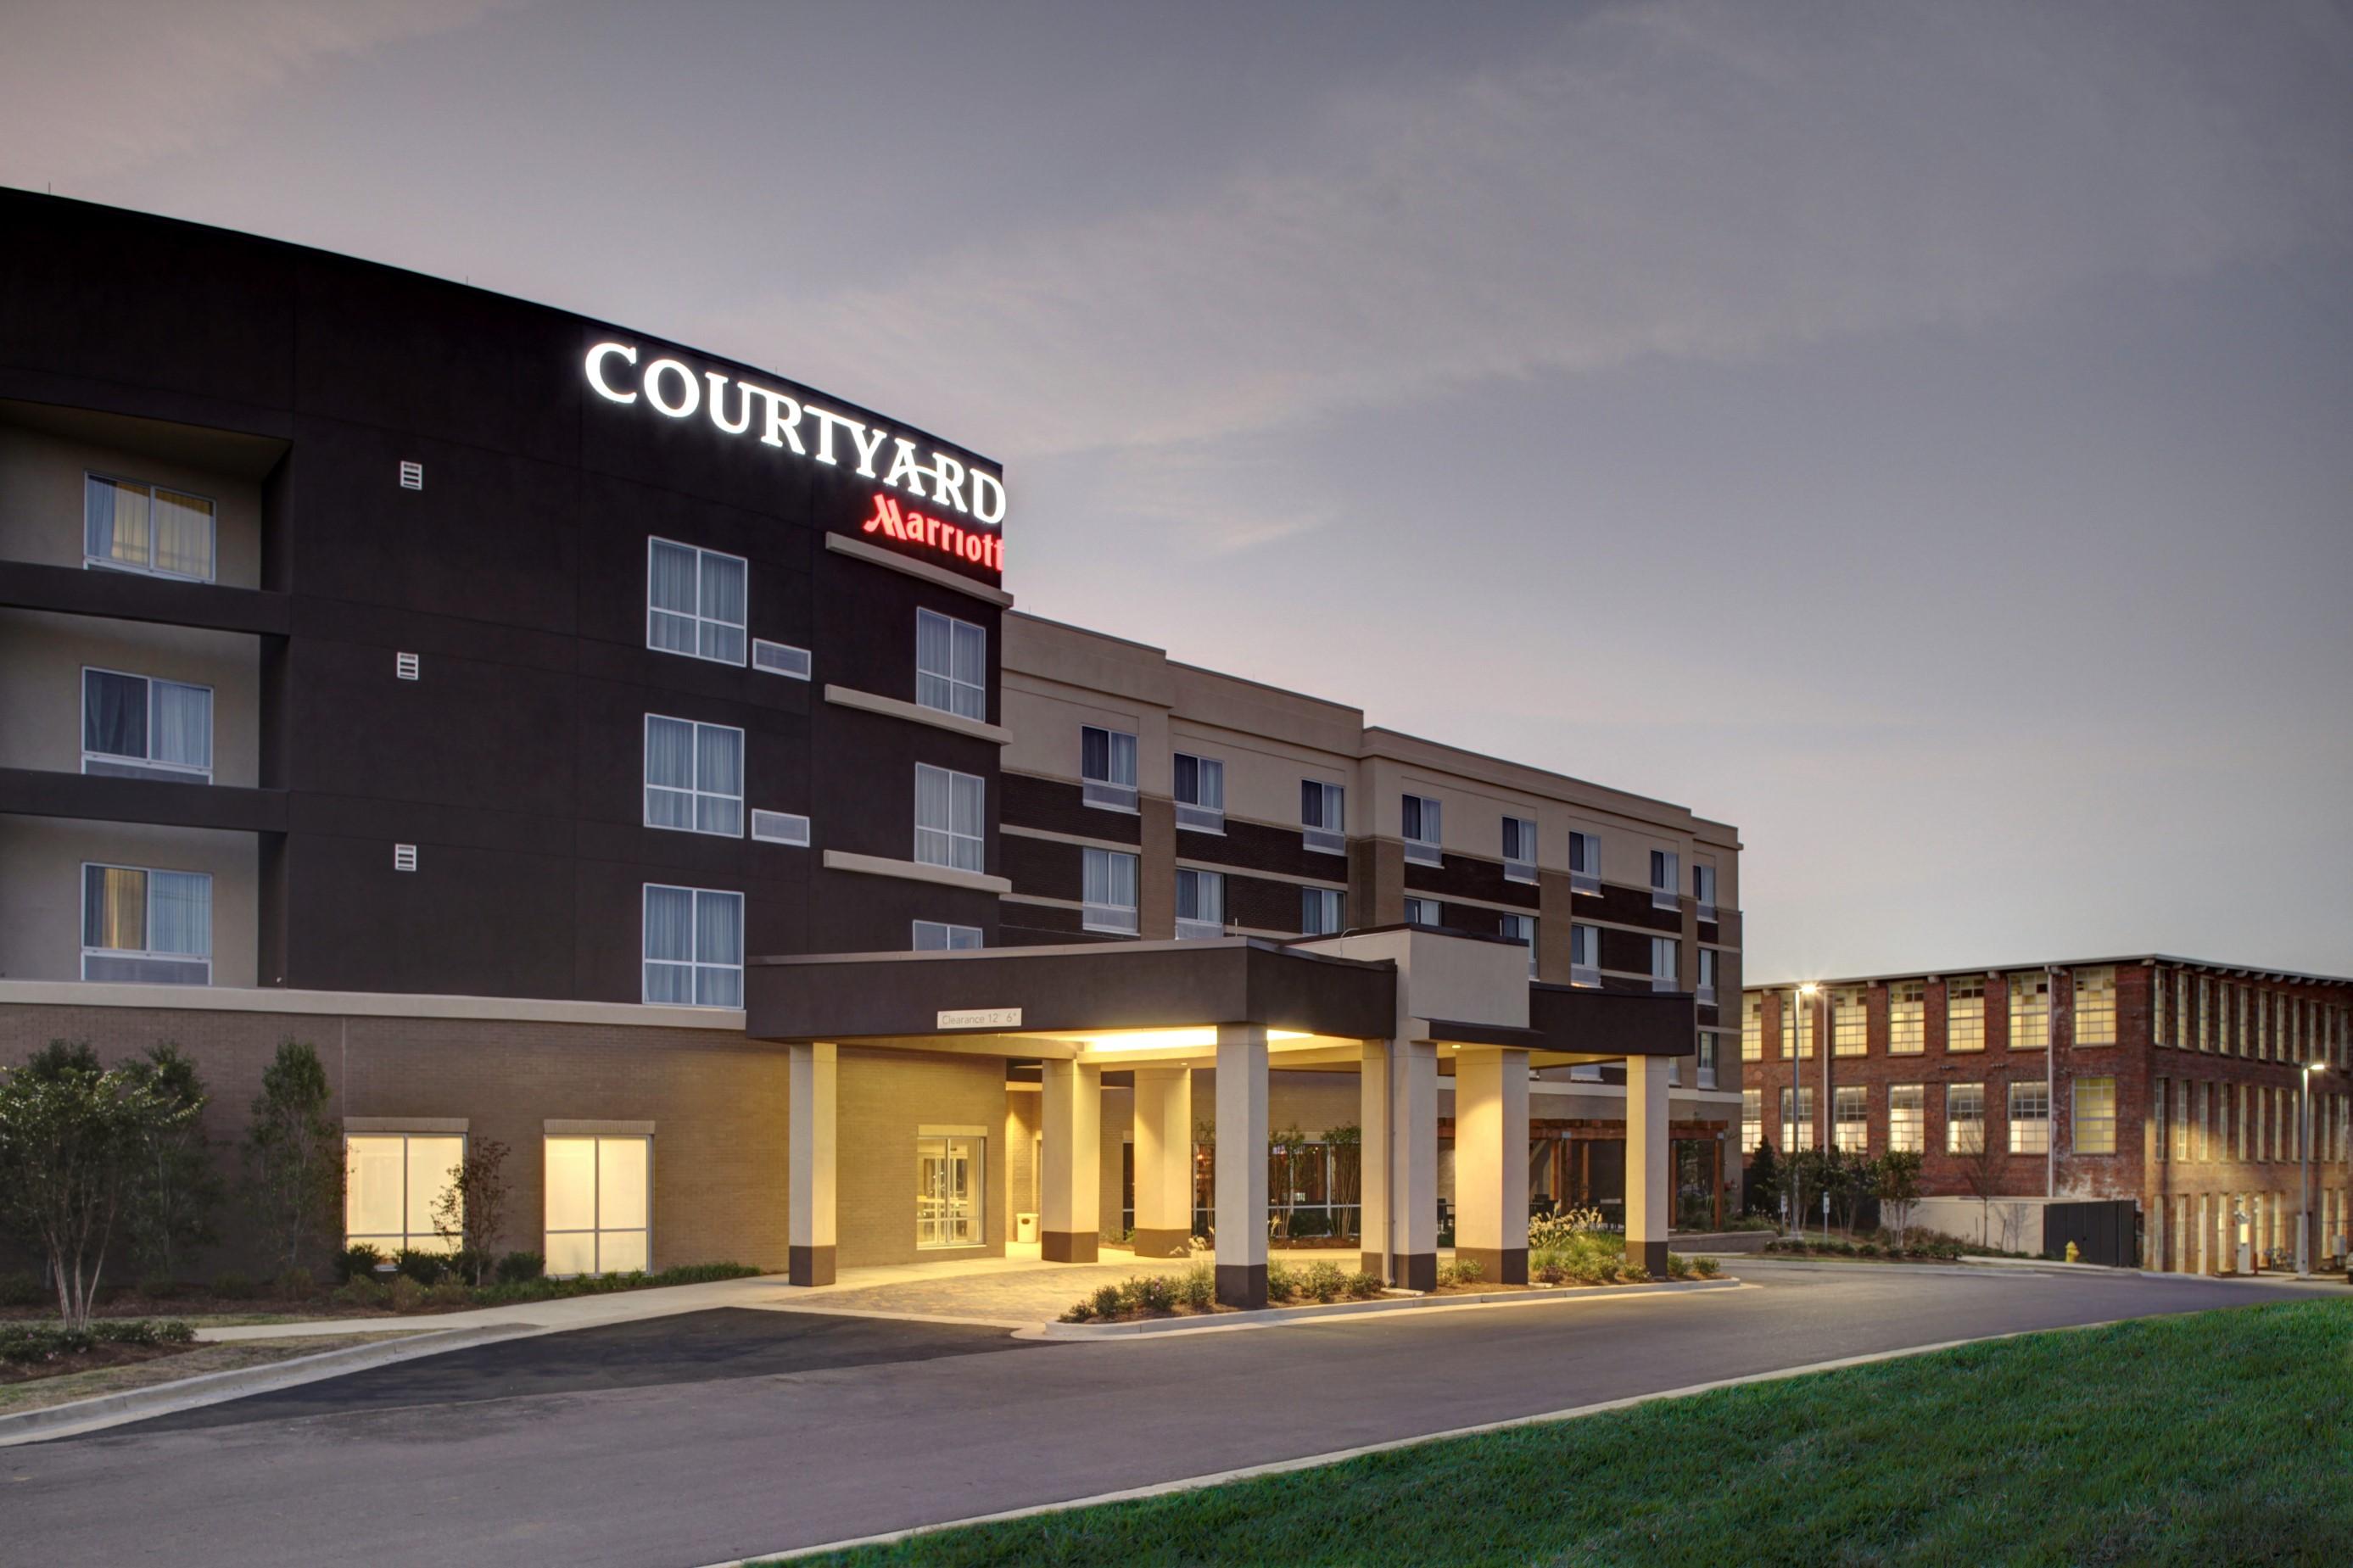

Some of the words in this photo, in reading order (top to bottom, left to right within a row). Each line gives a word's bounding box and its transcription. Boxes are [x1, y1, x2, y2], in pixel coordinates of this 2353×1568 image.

[584, 342, 1007, 524] COURTYARD
[863, 494, 1005, 572] Marriott
[942, 1015, 985, 1025] Clearance
